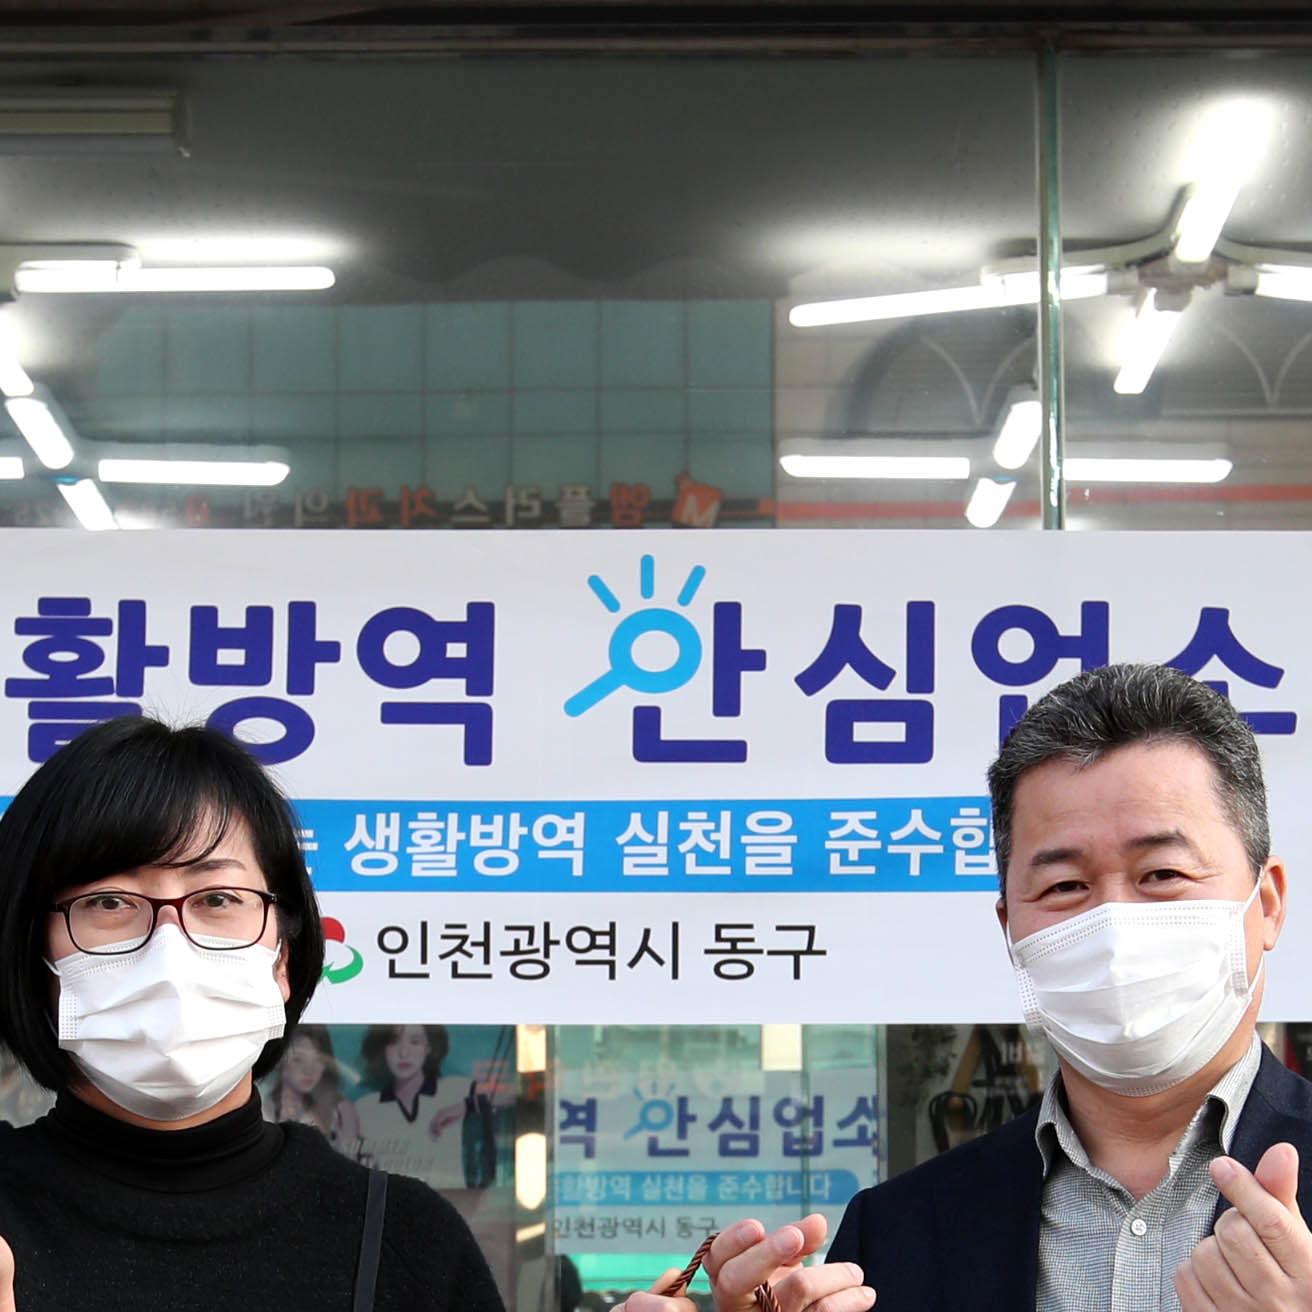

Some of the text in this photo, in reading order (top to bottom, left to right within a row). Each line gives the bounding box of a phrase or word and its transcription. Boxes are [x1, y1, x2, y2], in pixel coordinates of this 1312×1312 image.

[564, 598, 1297, 766] 안심업소
[343, 811, 588, 876] 생활방역
[614, 809, 799, 876] 실천을
[823, 808, 998, 876] 준수합
[376, 918, 829, 981] 인천광역시 동구
[640, 1174, 707, 1200] 실천을
[717, 1173, 832, 1200] 준수합니다
[552, 1216, 720, 1240] 인천광역시 동구
